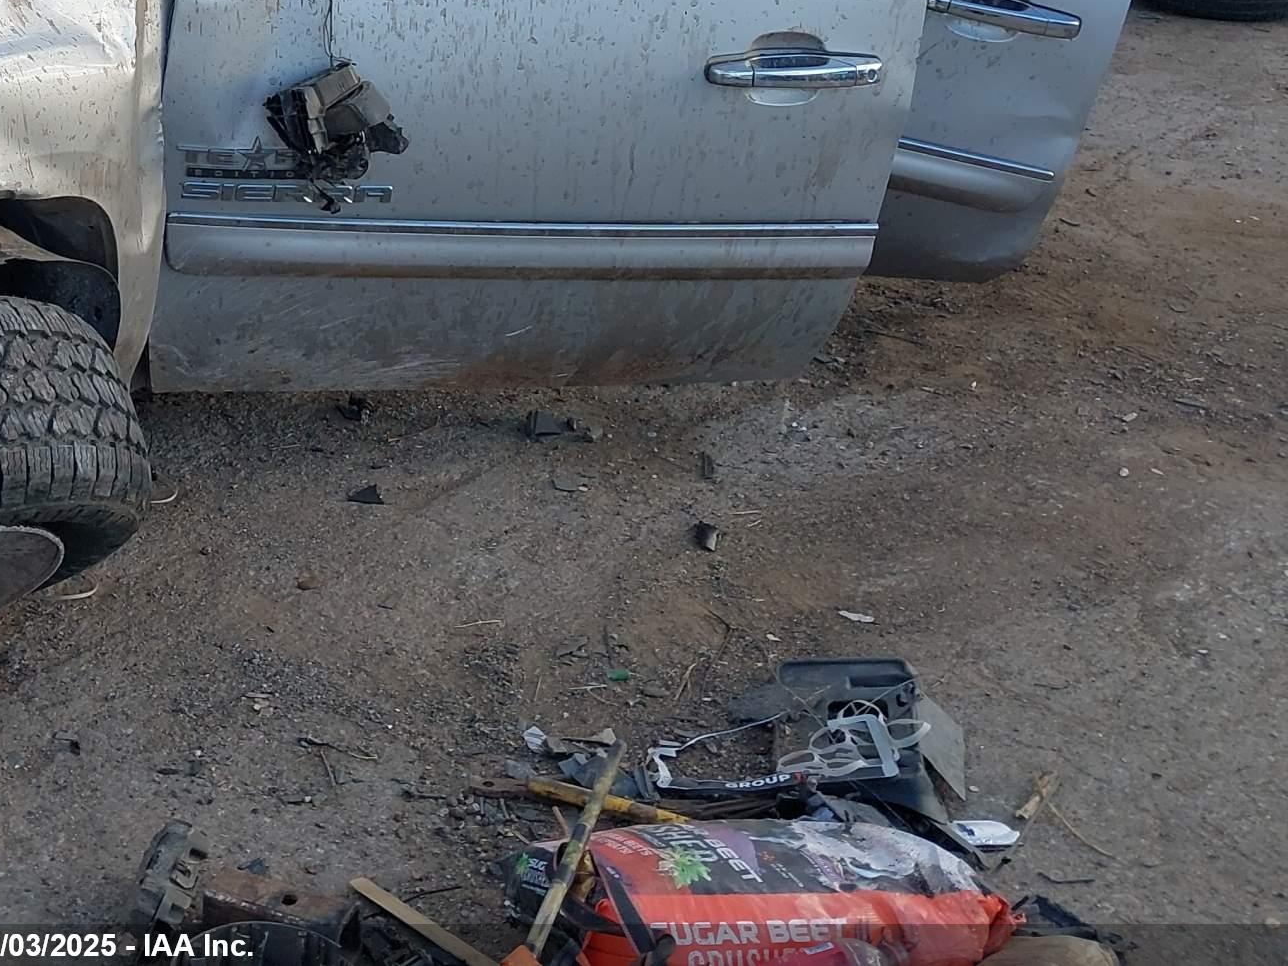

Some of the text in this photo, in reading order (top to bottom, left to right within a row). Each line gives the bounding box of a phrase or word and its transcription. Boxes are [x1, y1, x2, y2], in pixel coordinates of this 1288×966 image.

[181, 181, 393, 203] SIERRA
[725, 773, 791, 789] GROUP
[704, 839, 763, 883] BEET
[766, 918, 847, 943] BEET
